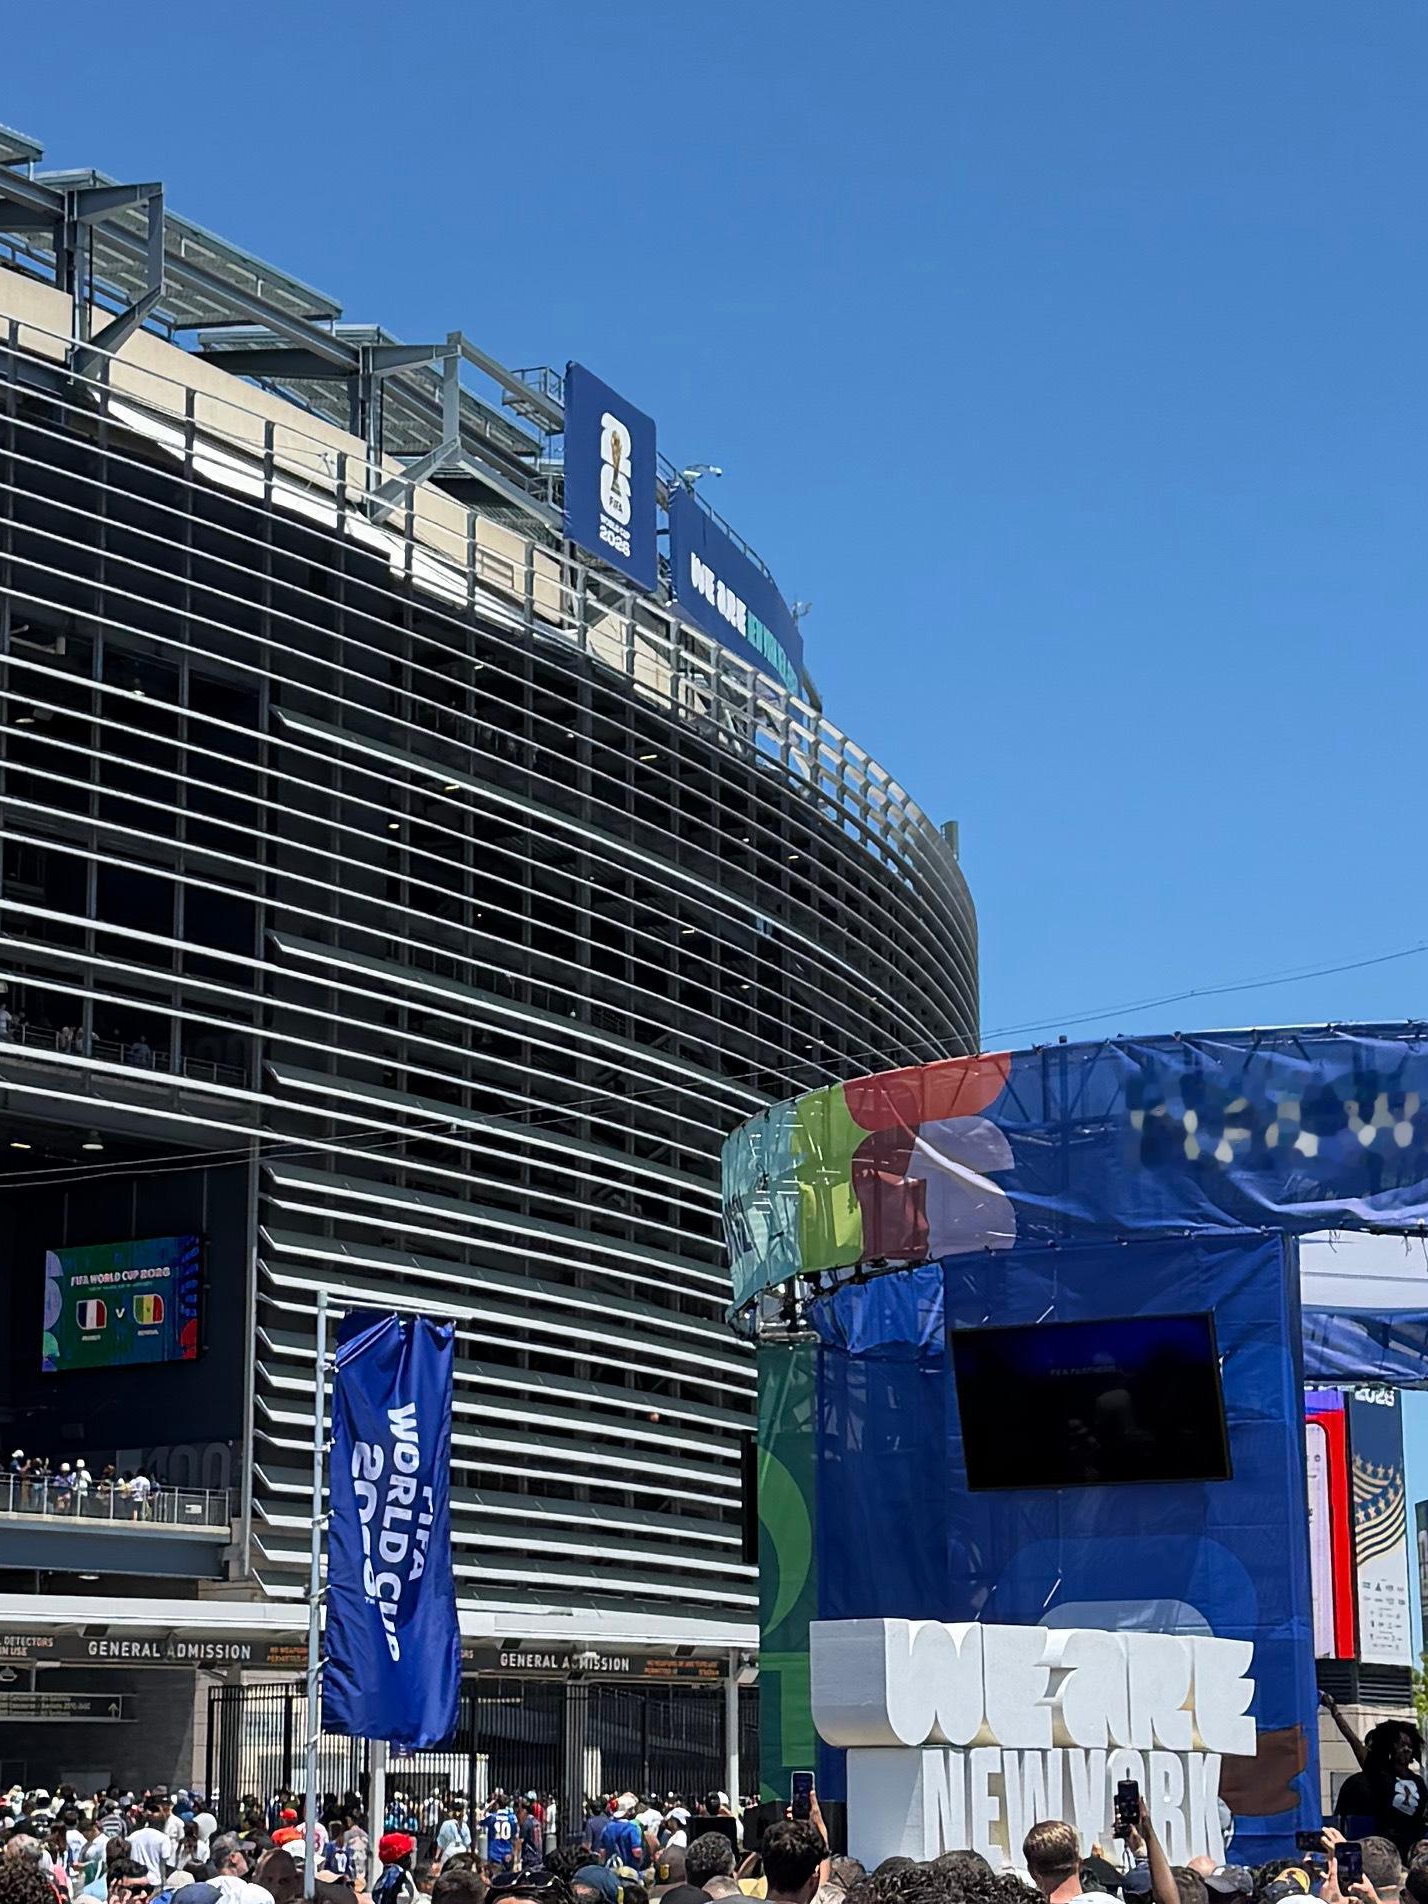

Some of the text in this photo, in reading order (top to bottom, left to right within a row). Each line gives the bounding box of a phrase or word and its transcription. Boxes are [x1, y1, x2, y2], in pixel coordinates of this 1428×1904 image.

[375, 1402, 420, 1662] WORLD CUP
[3, 1636, 53, 1647] DETECTORS
[88, 1641, 160, 1657] GENERAL
[165, 1643, 251, 1660] ADMISSION
[0, 1647, 27, 1657] IN USE
[500, 1652, 558, 1669] GENERAL
[885, 1620, 1052, 1748] WE
[921, 1747, 1064, 1864] NEW
[494, 1821, 511, 1840] 10
